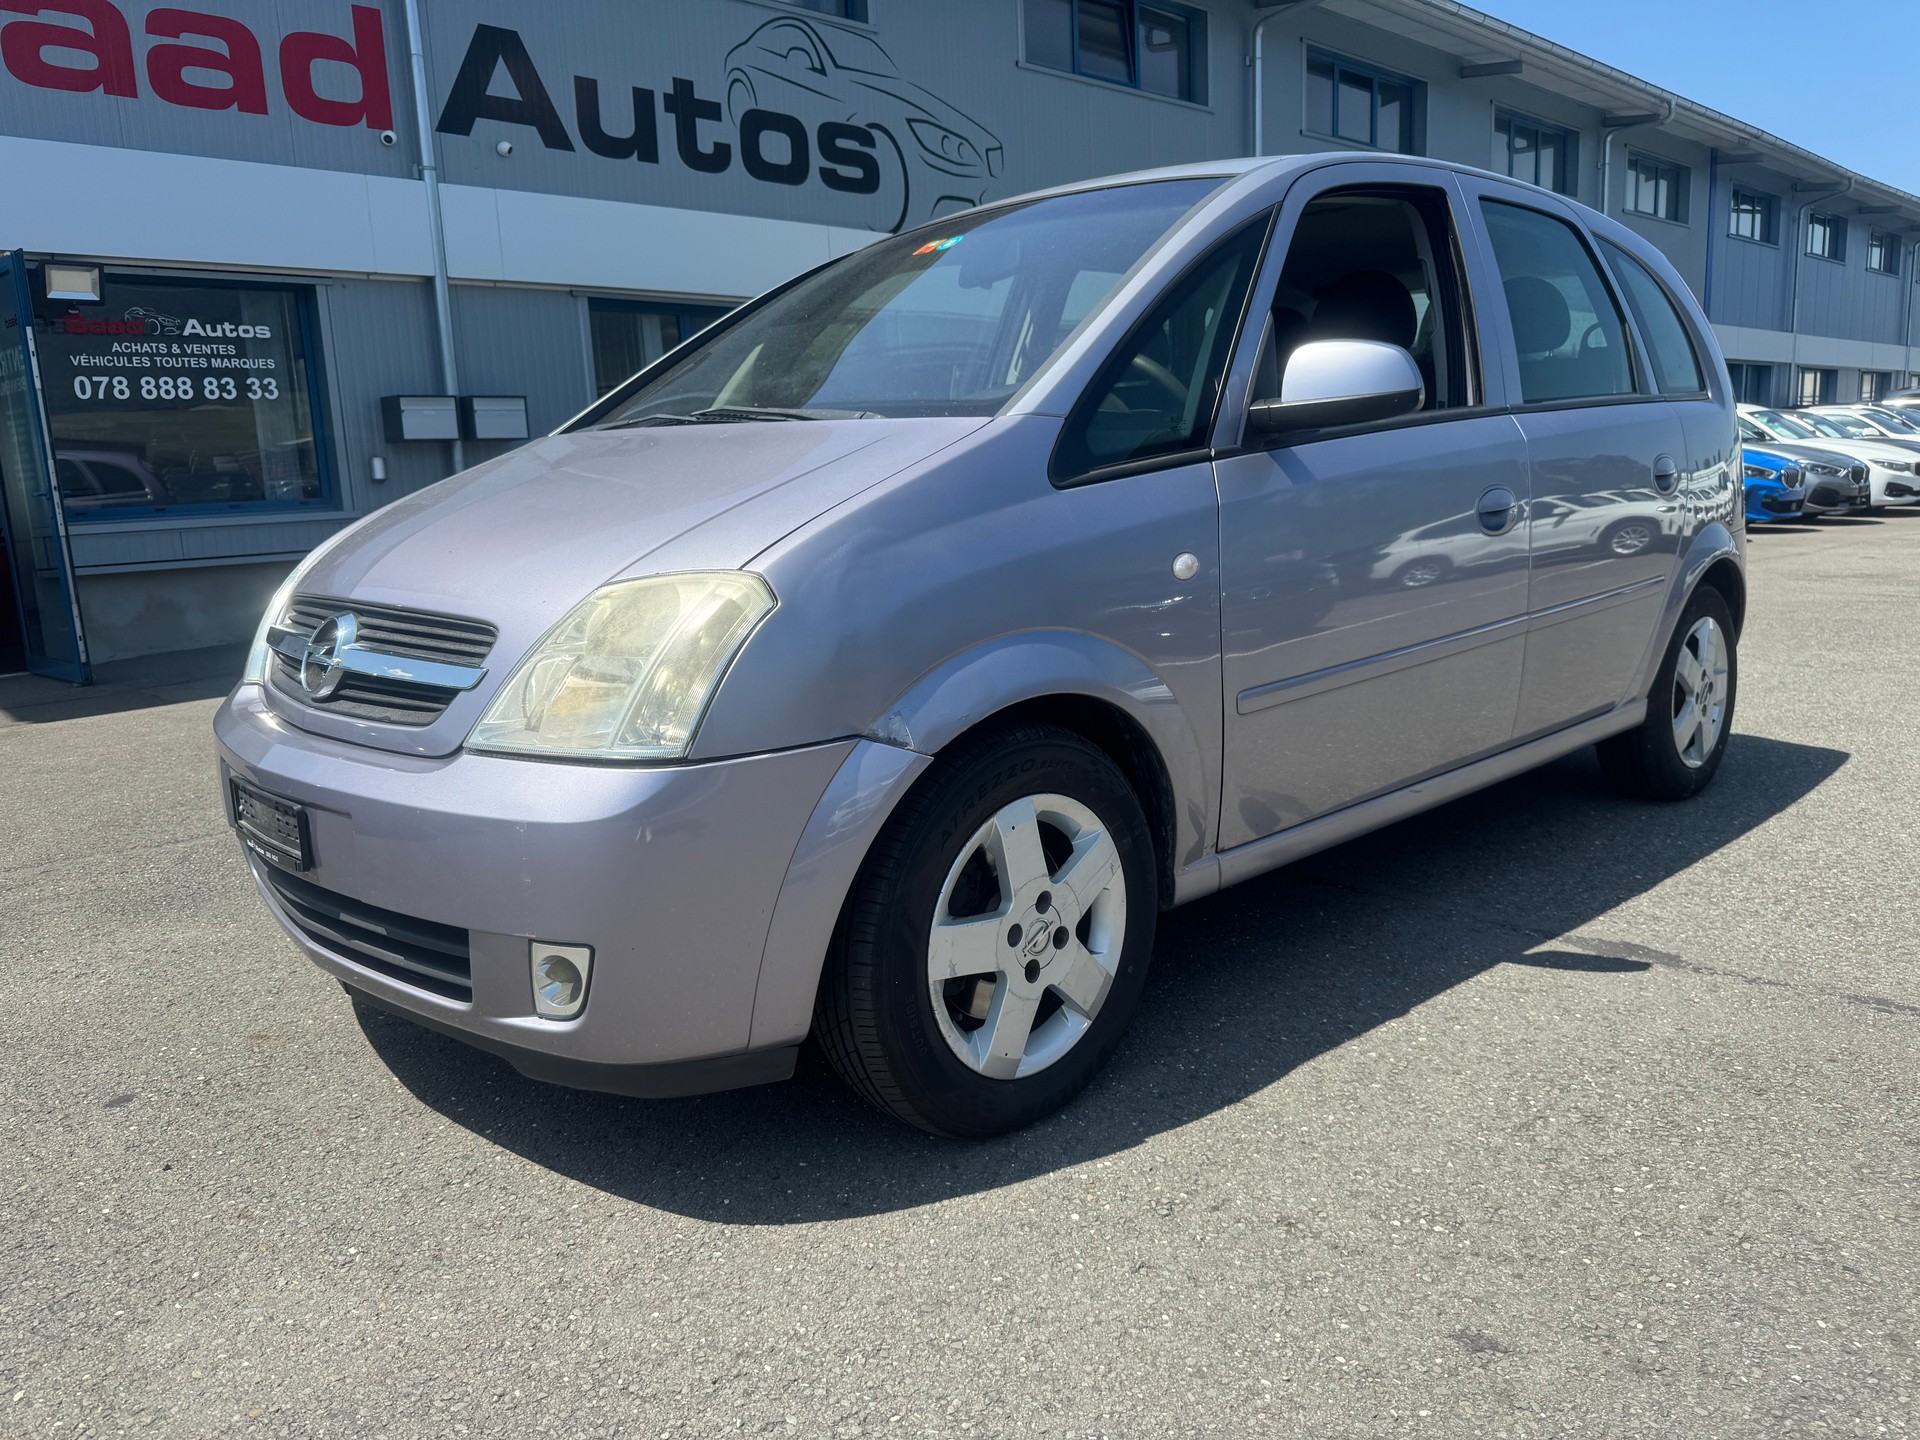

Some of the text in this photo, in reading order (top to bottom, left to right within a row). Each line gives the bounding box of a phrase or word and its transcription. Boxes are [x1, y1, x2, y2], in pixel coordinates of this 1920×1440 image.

[435, 23, 880, 195] Autos
[183, 318, 272, 339] Autos
[111, 342, 236, 355] ACHATS & VENTES
[69, 353, 275, 370] VÉHICULES TOUTES MARQUES
[73, 375, 279, 400] 078 888 83 33
[940, 758, 1076, 853] ATREZZO ELITE
[904, 993, 929, 1057] OUTSIDE
